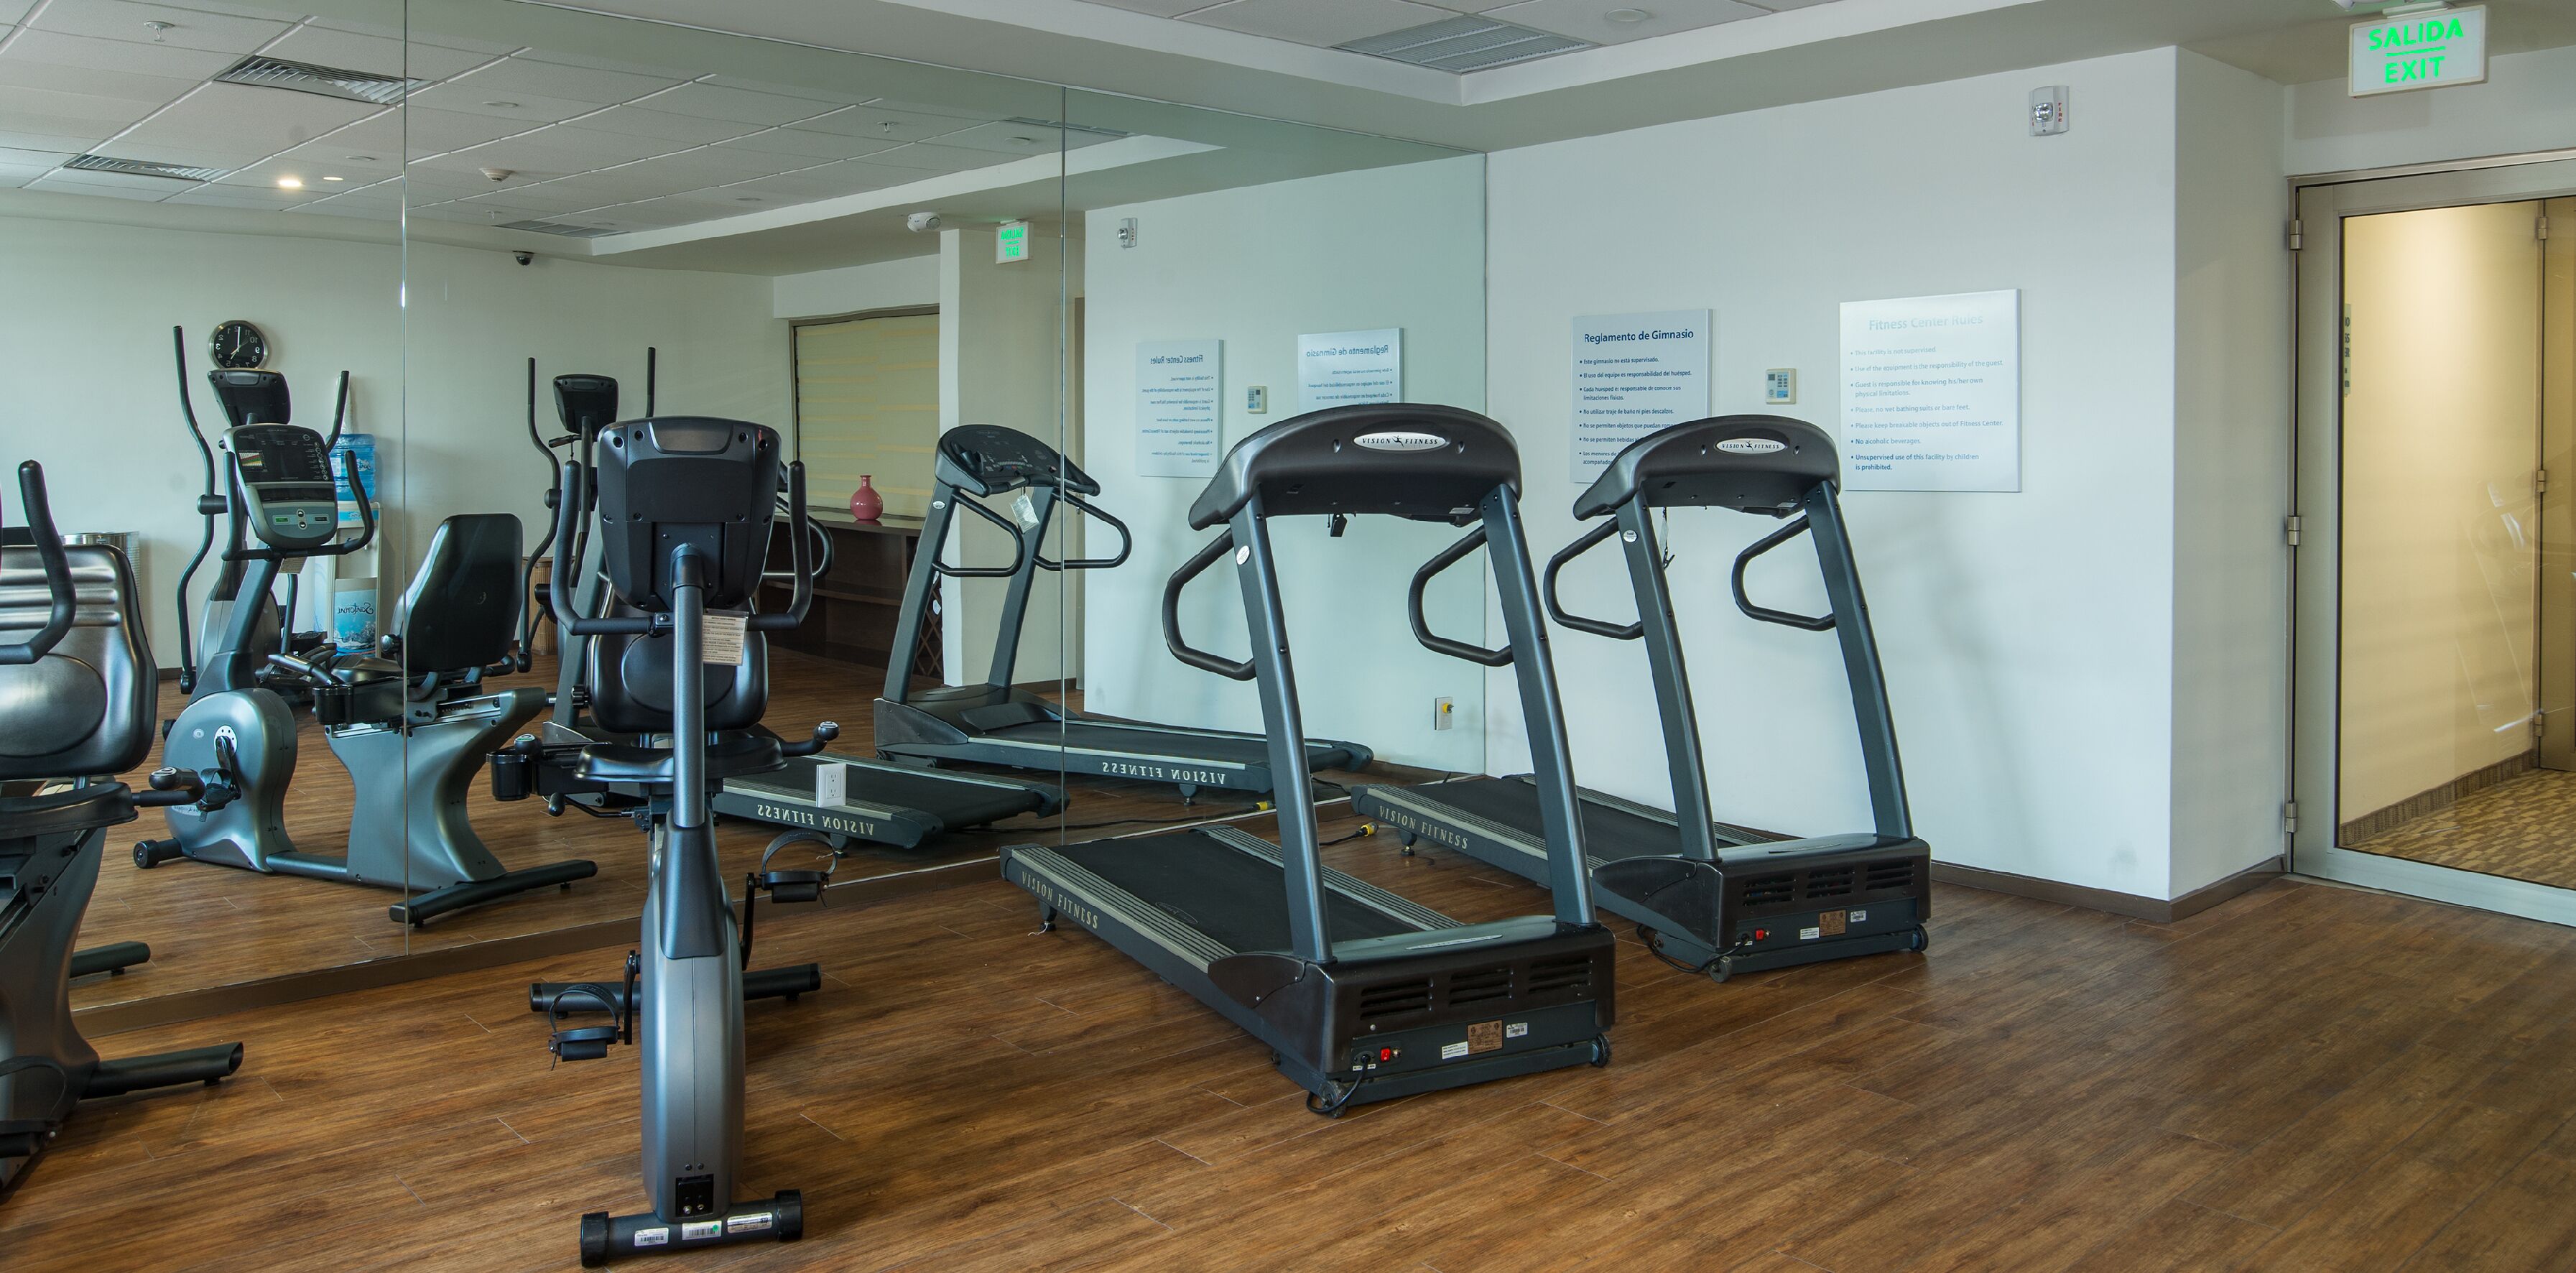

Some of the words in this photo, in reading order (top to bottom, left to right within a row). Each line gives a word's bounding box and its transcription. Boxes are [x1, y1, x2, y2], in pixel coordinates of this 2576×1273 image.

[2368, 18, 2464, 51] SALIDA
[2385, 56, 2445, 84] EXIT
[1585, 333, 1636, 345] Reglamento
[1639, 330, 1649, 341] de
[1652, 328, 1694, 339] Gimnasio
[1869, 320, 1907, 330] Fitness
[1911, 317, 1948, 328] Center
[1952, 315, 1983, 325] Rules
[1878, 379, 1911, 388] responsible
[1921, 378, 1947, 386] knowing
[1379, 805, 1417, 829] VISION
[1421, 822, 1468, 849] FITNESS
[1021, 871, 1053, 902] VISION
[1057, 894, 1098, 929] FITNESS
